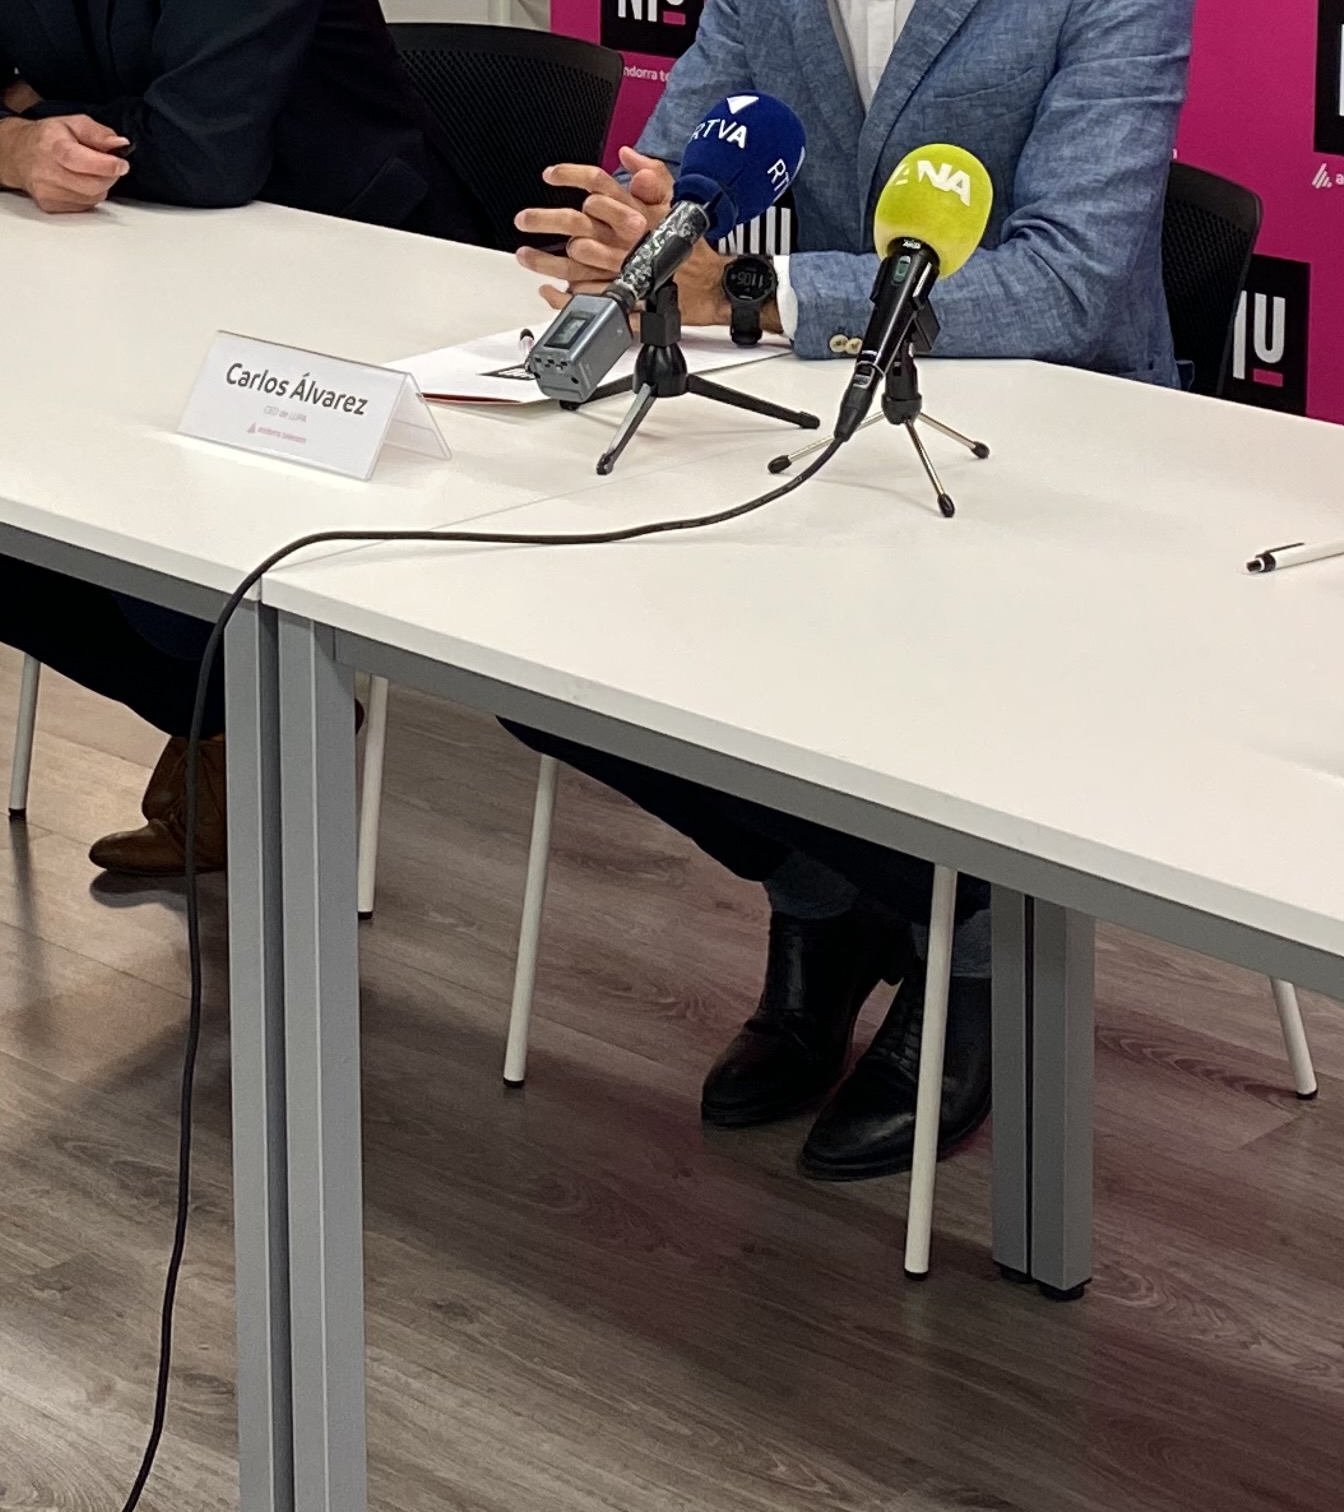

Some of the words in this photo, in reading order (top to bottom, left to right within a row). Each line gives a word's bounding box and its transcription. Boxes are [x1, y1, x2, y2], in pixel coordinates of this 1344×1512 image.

[623, 65, 658, 81] ndorra
[688, 118, 747, 149] RTVA
[1233, 290, 1286, 380] IU
[226, 362, 290, 397] Carlos
[288, 372, 369, 416] Álvarez
